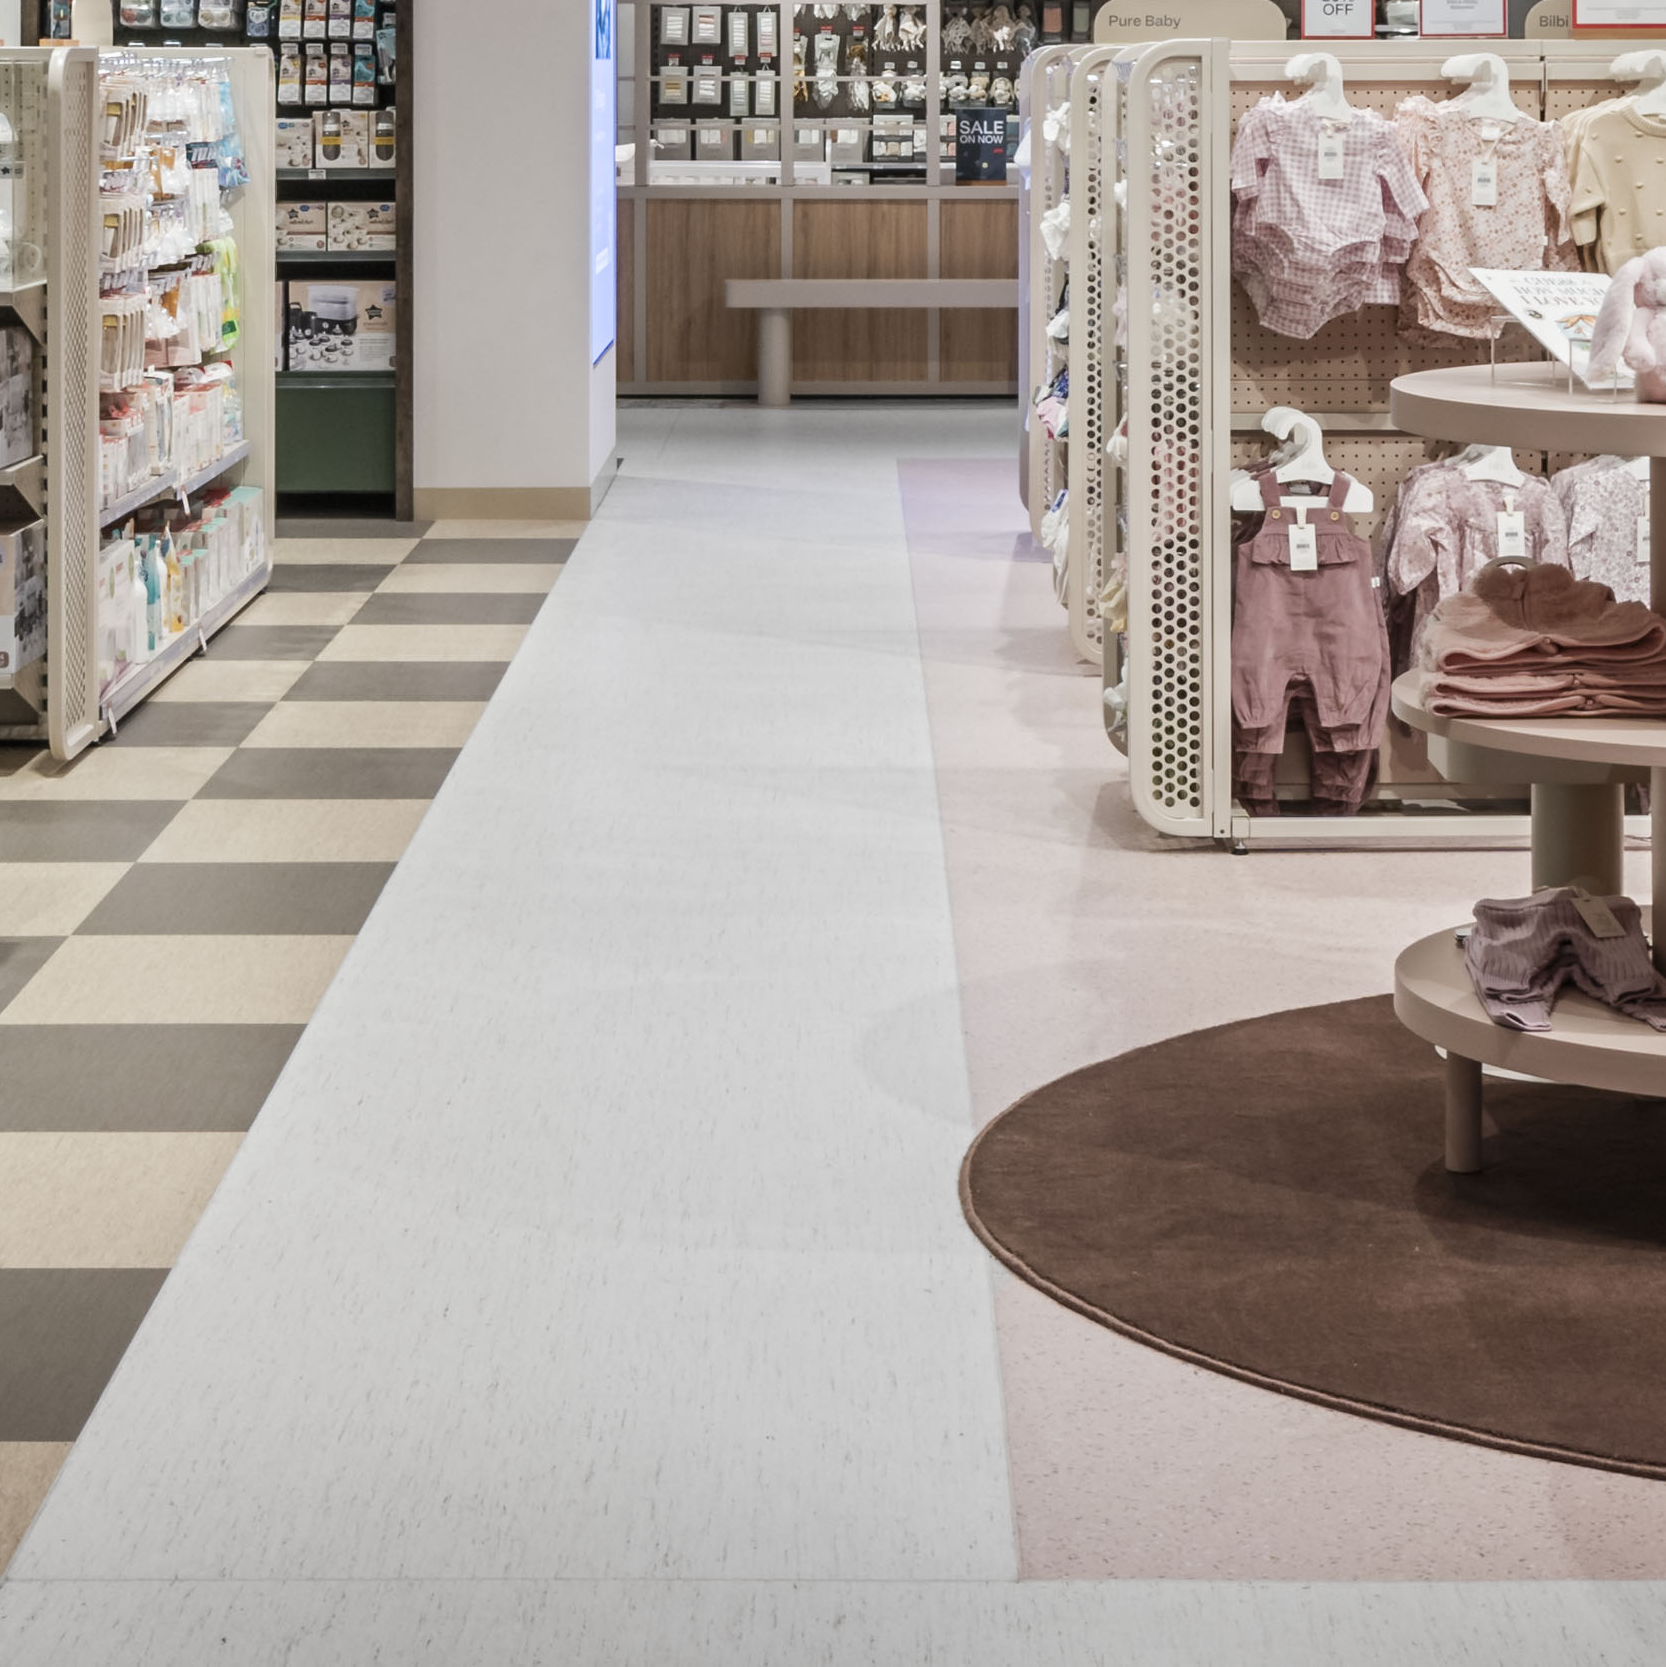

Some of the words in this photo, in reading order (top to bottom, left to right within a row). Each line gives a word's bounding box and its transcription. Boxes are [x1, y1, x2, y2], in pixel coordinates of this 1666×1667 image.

[1323, 3, 1354, 16] OFF
[1108, 15, 1142, 27] Pure
[1145, 15, 1181, 30] Baby
[1539, 15, 1569, 27] Bilbi
[959, 120, 1004, 134] SALE
[959, 135, 975, 144] ON
[978, 135, 1003, 144] NOW
